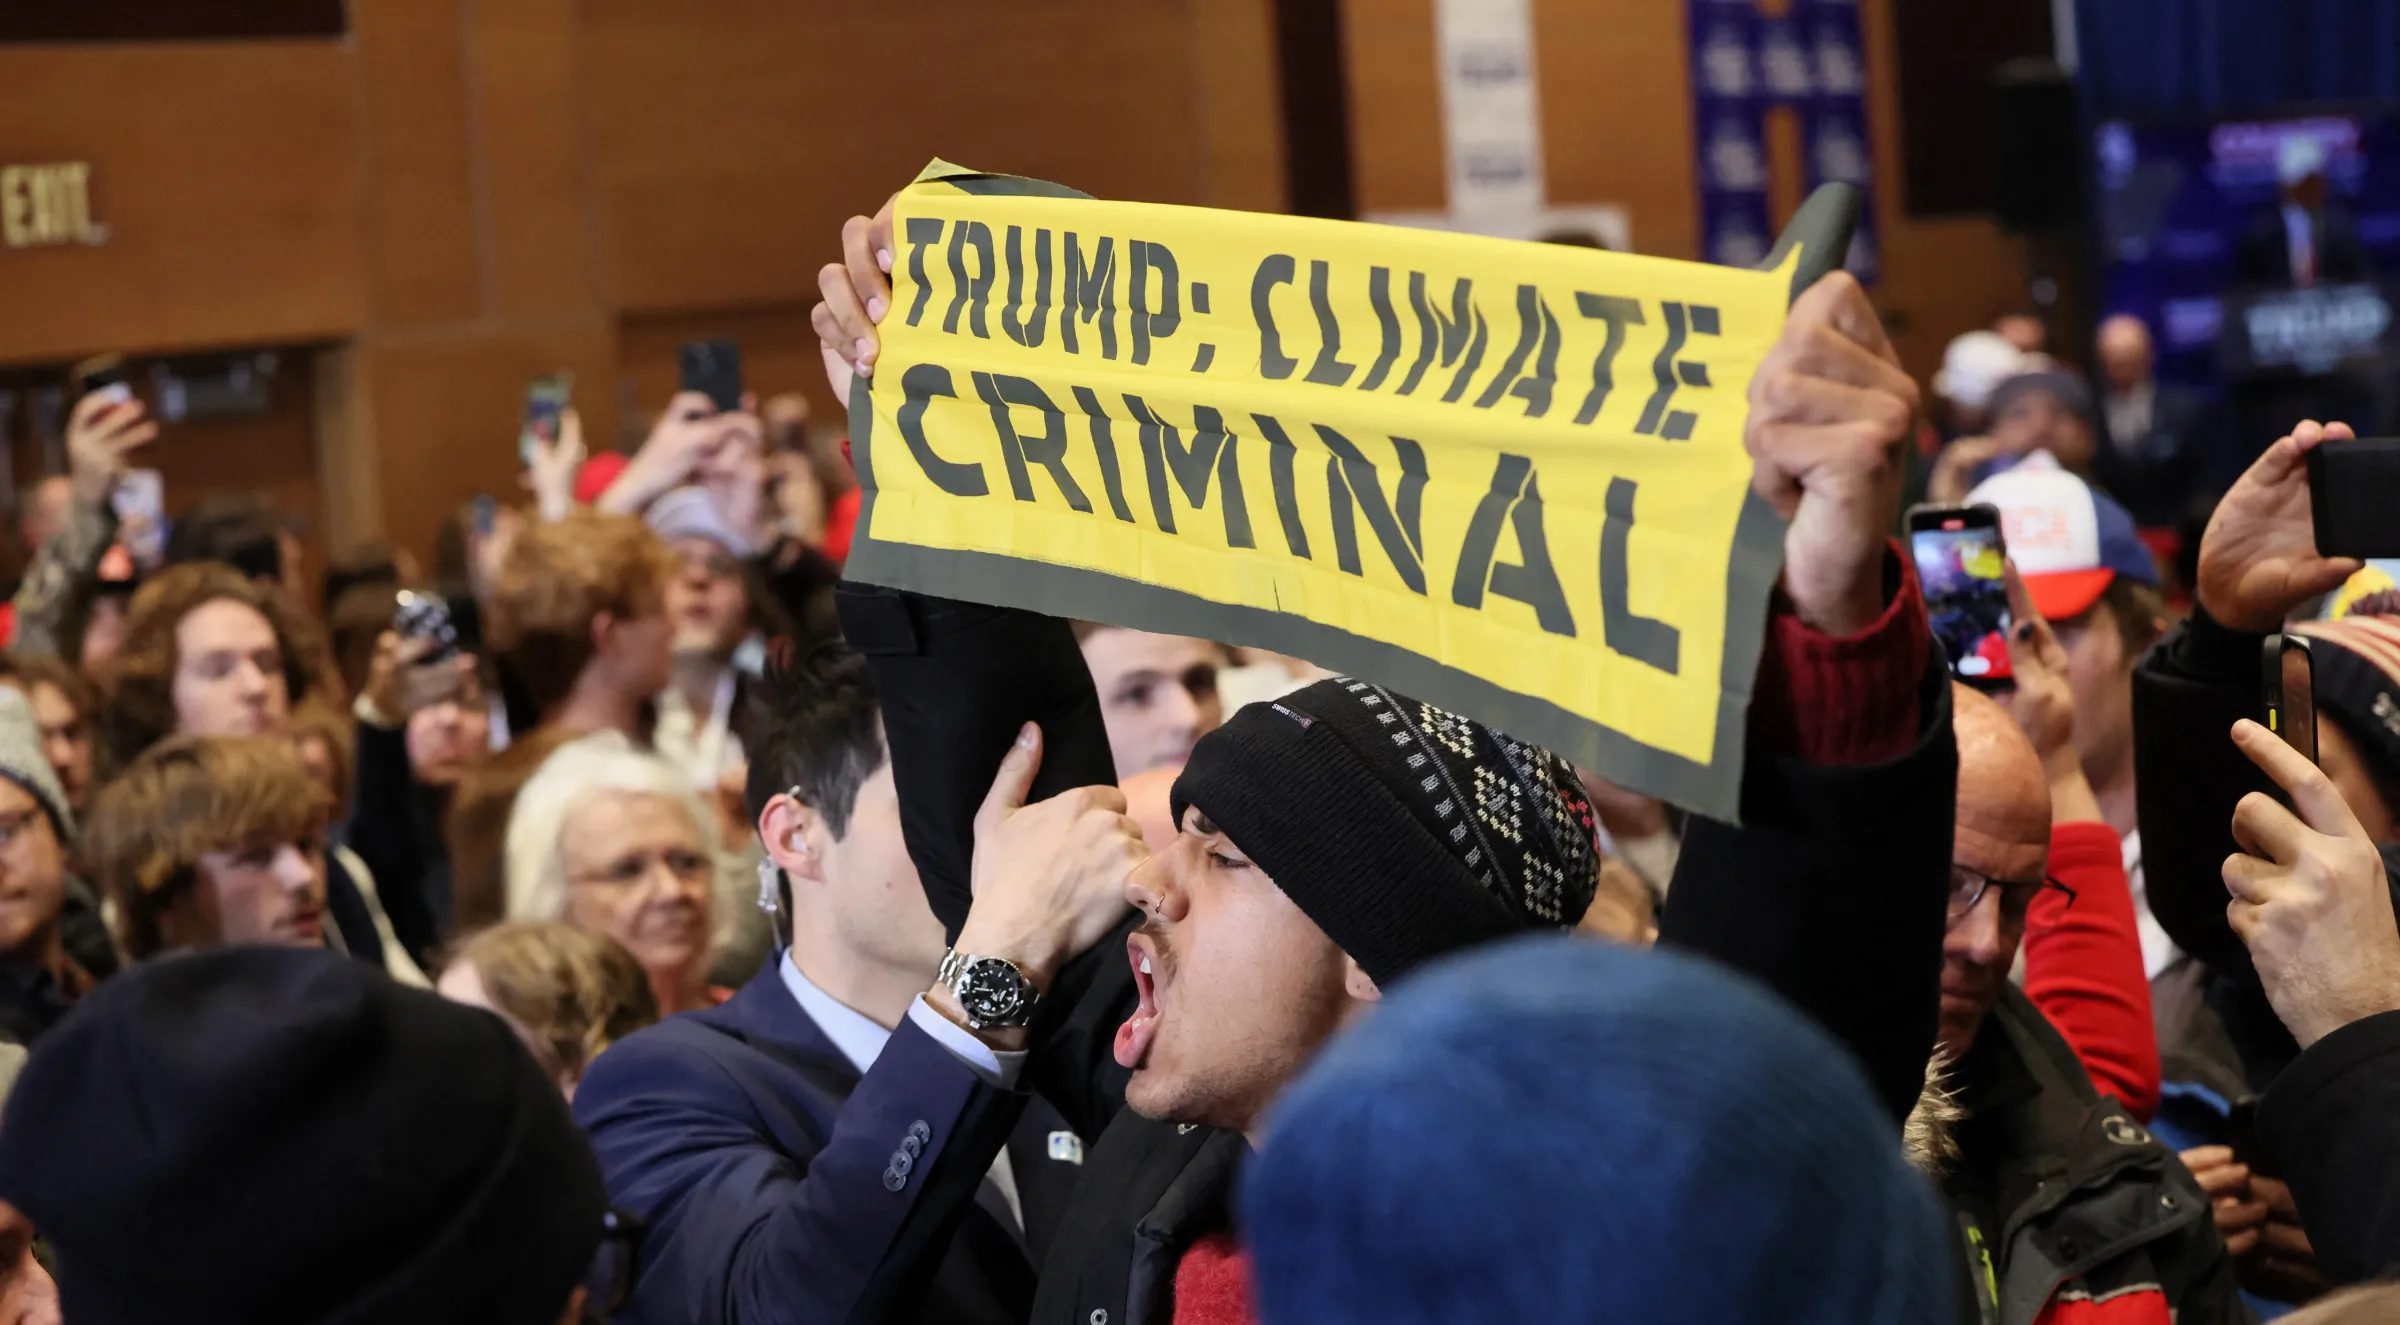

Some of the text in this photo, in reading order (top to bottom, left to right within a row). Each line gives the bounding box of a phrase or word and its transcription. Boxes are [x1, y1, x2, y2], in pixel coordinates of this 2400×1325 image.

[2, 163, 91, 246] EXIT
[1251, 253, 1721, 442] CLIMATE
[896, 363, 1681, 676] CRIMINAL
